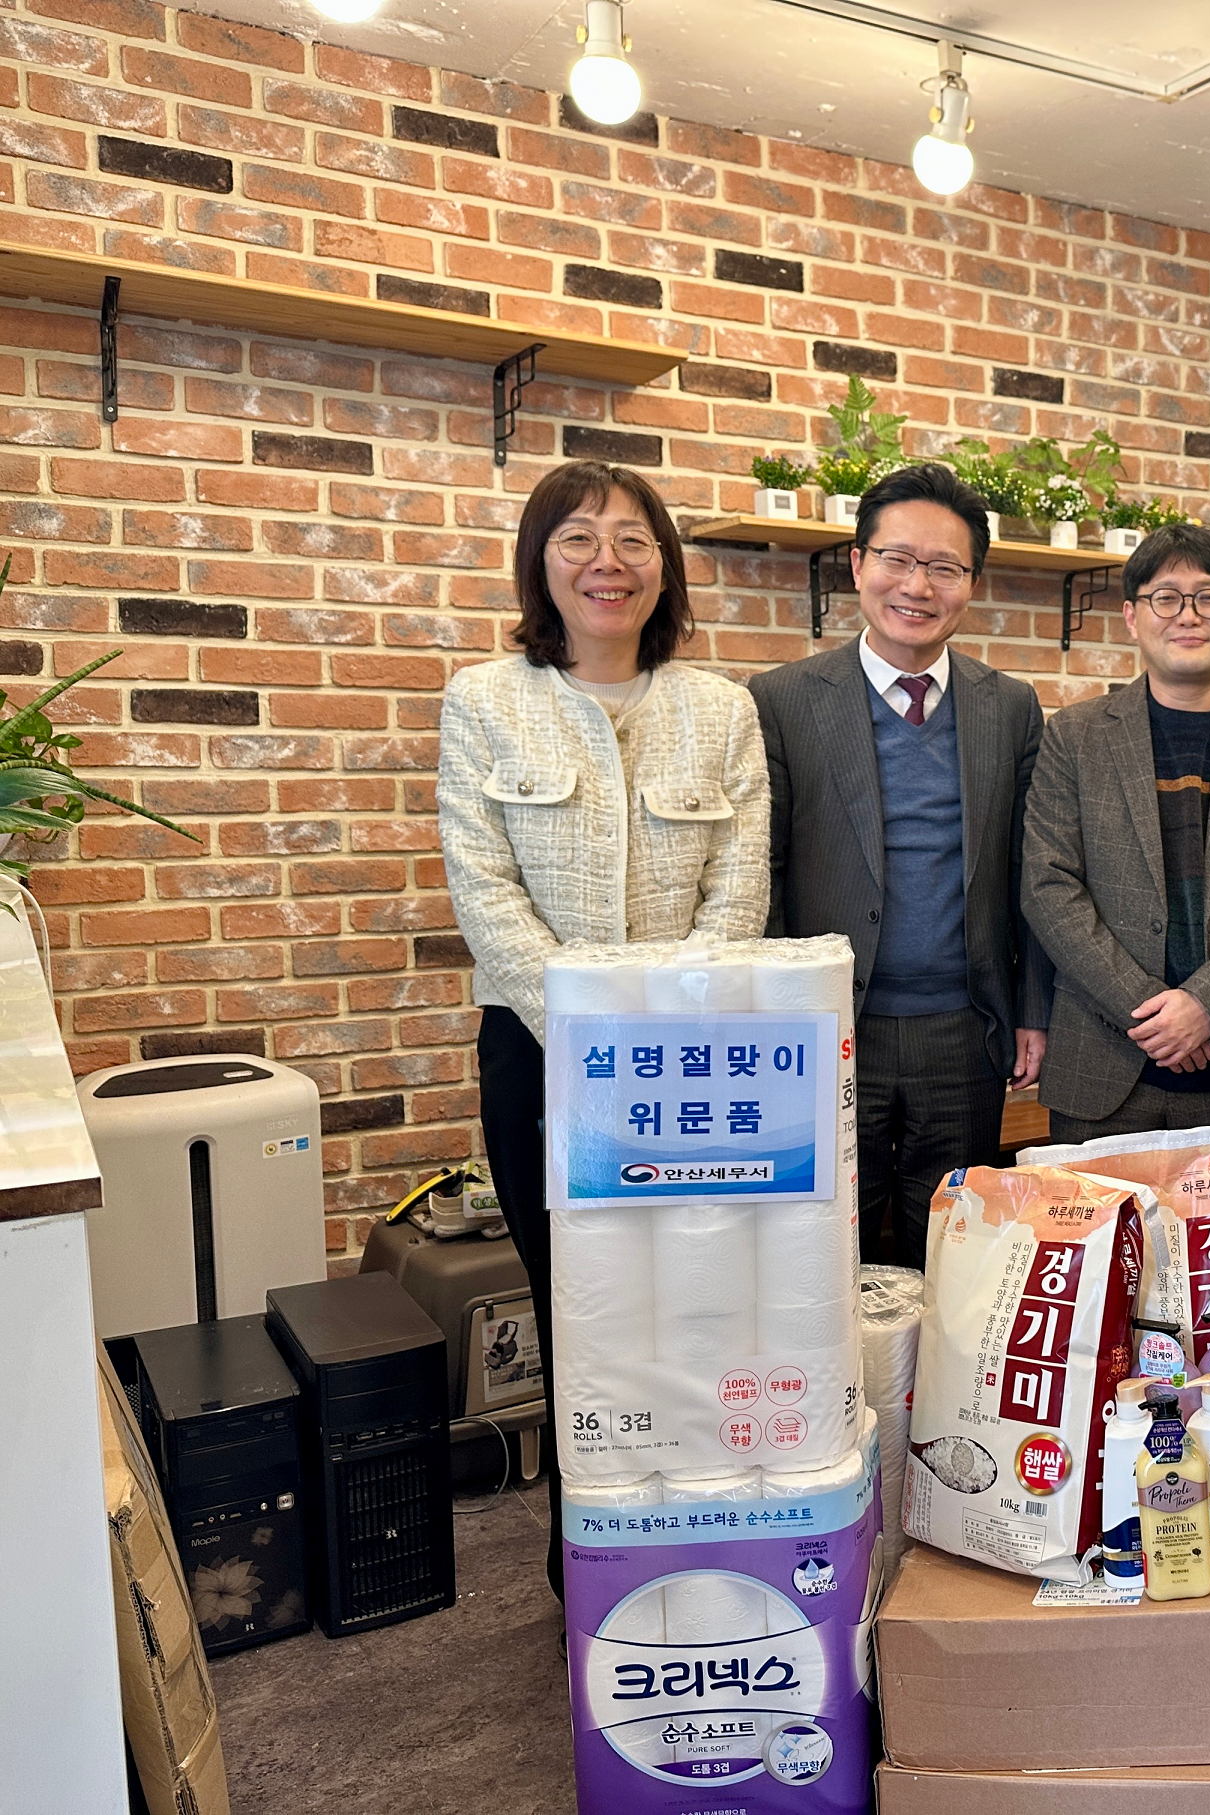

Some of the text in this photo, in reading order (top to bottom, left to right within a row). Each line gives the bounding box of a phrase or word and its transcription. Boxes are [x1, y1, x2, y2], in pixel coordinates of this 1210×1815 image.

[663, 1165, 768, 1181] 안산세무서
[1048, 1205, 1095, 1220] 하루세끼쌀
[1169, 1222, 1181, 1257] 미질이
[1172, 1260, 1184, 1294] 우수한
[988, 1243, 1033, 1368] 미질이 우수한 맛있는 쌀
[970, 1242, 1022, 1412] 비옥한 토양과 풍부한 일조량으로
[1011, 1247, 1074, 1421] 경기미
[1146, 1338, 1173, 1350] 핑크솔트
[1146, 1349, 1173, 1361] 각질케어
[725, 1378, 756, 1390] 100%
[770, 1379, 803, 1392] 무형광
[723, 1389, 758, 1401] 천연펄프
[844, 1381, 857, 1405] 36
[572, 1411, 600, 1431] 36
[619, 1411, 652, 1433] 3겹
[573, 1432, 603, 1441] ROLLS
[729, 1423, 751, 1435] 무색
[730, 1435, 752, 1447] 무향
[1150, 1435, 1179, 1449] 100%
[1023, 1447, 1063, 1482] 햅쌀
[999, 1497, 1021, 1513] 10kg
[582, 1518, 604, 1532] 7%
[608, 1518, 621, 1532] 더
[687, 1512, 740, 1529] 부드러운
[745, 1507, 814, 1526] 순수소프트
[1156, 1521, 1197, 1535] PROTEIN
[191, 1535, 221, 1547] Maple
[795, 1540, 828, 1551] 크리넥스
[612, 1655, 801, 1700] 크리넥스
[661, 1721, 757, 1745] 순수소프트
[711, 1744, 731, 1752] SOFT
[691, 1762, 730, 1775] 도톰 3겹
[777, 1759, 821, 1774] 무색무향
